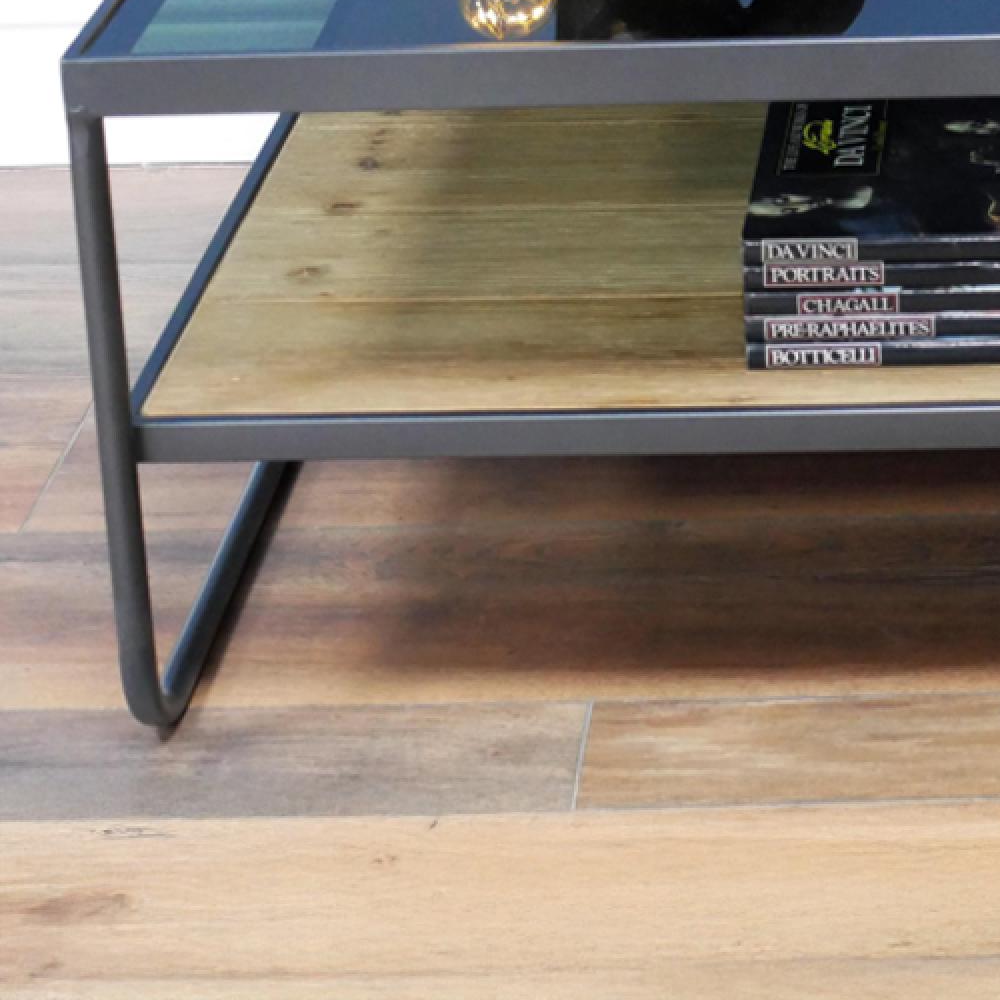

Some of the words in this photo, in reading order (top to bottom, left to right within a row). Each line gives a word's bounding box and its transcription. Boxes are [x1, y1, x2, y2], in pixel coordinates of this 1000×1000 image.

[770, 266, 879, 283] PORTRAITS
[802, 298, 893, 313] CHAGALL
[772, 348, 876, 365] BOTTICELLI
